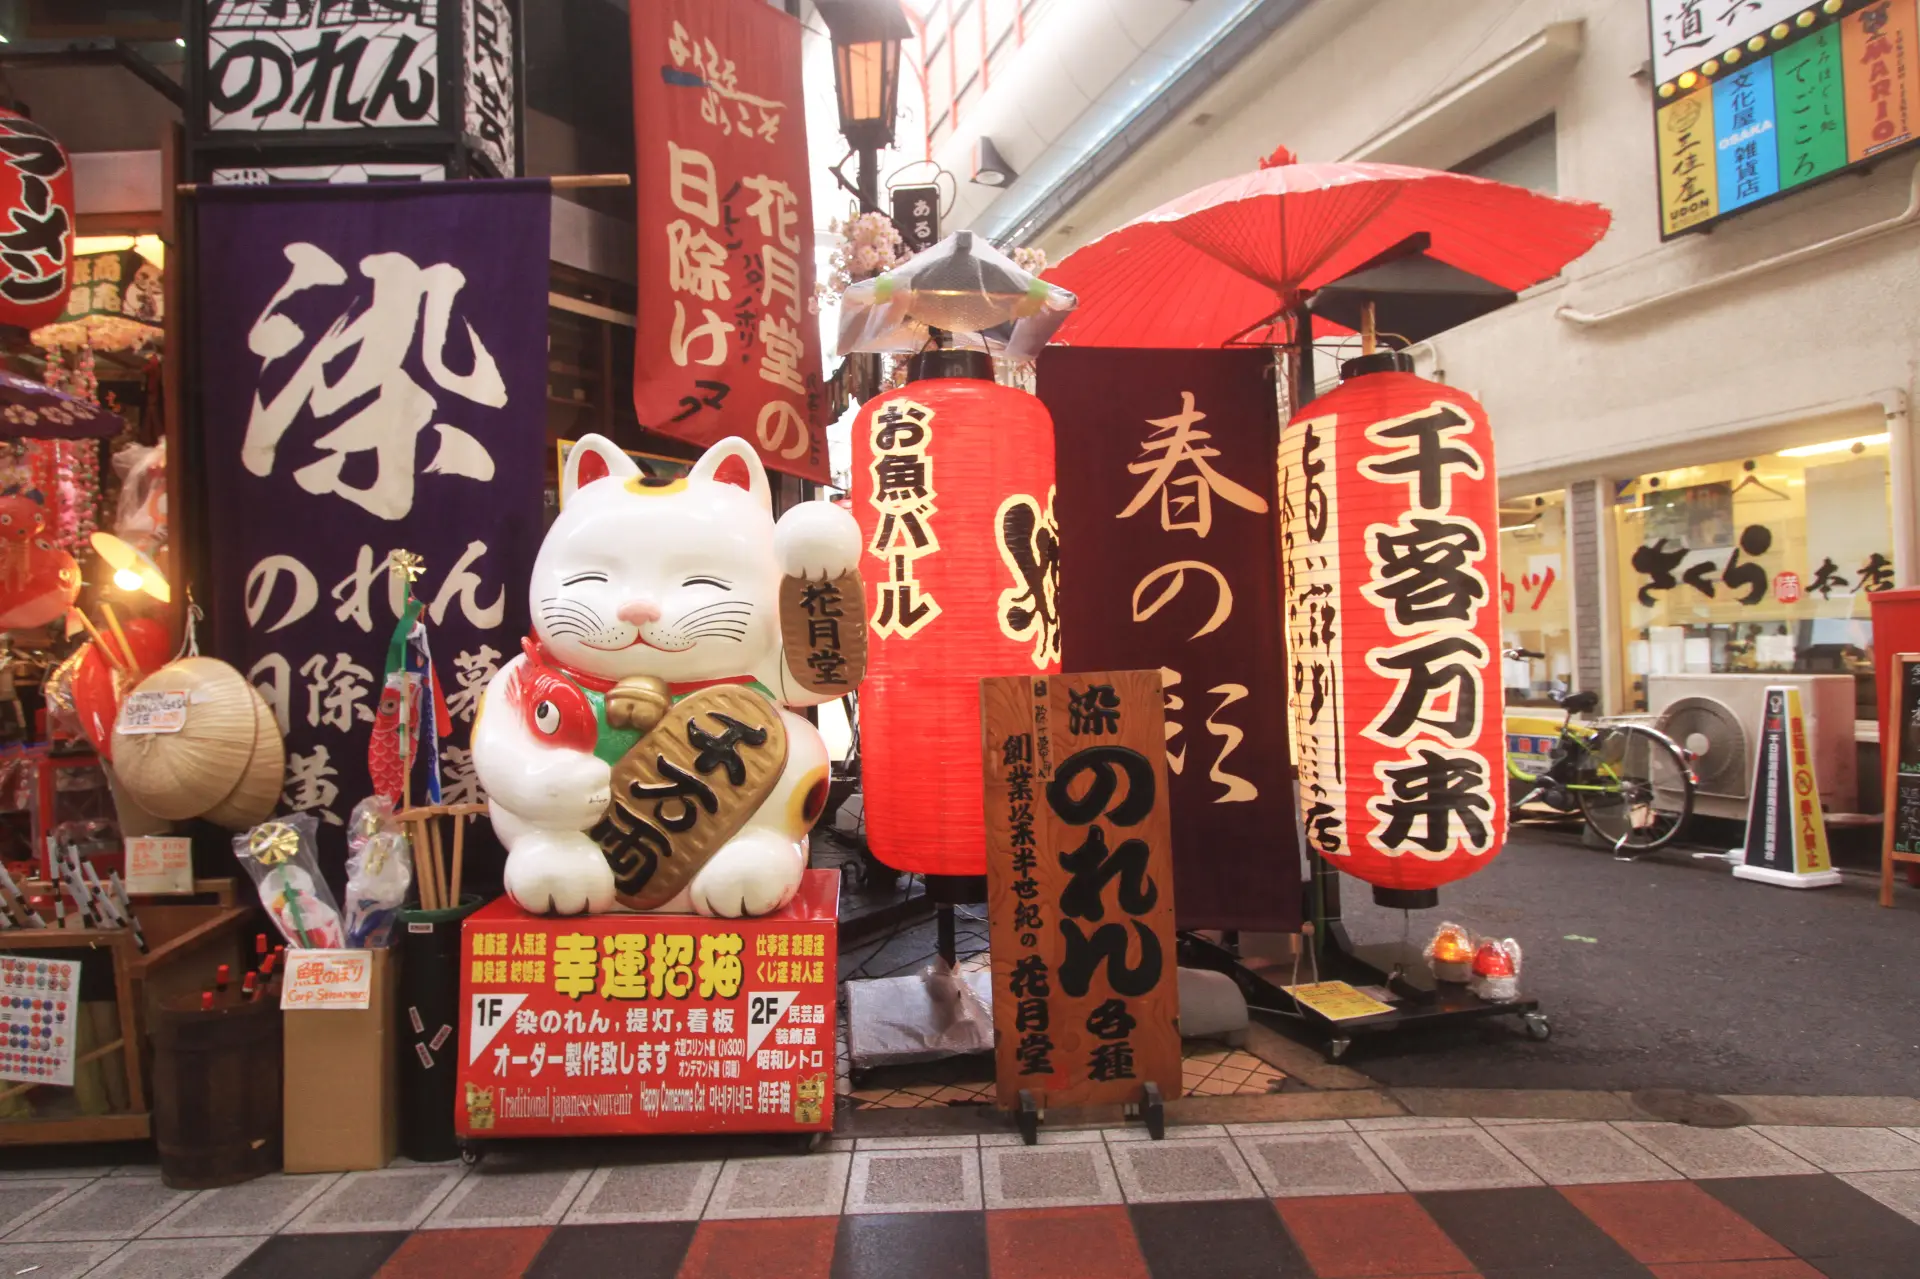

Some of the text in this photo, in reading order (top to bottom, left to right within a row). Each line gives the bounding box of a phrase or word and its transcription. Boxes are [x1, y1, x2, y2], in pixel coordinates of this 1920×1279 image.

[209, 31, 435, 123] のれん
[1731, 72, 1756, 130] 文化屋
[1860, 35, 1895, 141] MARIO
[1719, 120, 1773, 150] OSAKA
[1670, 198, 1709, 220] UDON
[666, 140, 737, 367] 日除け
[742, 174, 810, 461] 花月堂の
[242, 242, 508, 520] 染
[875, 404, 931, 629] お魚バール
[245, 540, 505, 633] のれん
[1631, 524, 1772, 607] さくら
[1804, 552, 1895, 601] 本店
[800, 582, 848, 686] 花月堂
[1368, 406, 1490, 853] 千客万来
[1002, 733, 1055, 1077] 創業以来半世紀の花月堂
[1046, 683, 1163, 1081] 染のれん各種
[553, 932, 743, 1000] 幸運招猫
[756, 934, 789, 957] 仕事運
[756, 961, 789, 984] くじ運
[477, 998, 503, 1027] 1F
[751, 997, 779, 1025] 2F
[775, 1028, 817, 1045] 装飾品
[787, 1005, 825, 1024] 民芸品
[493, 1041, 671, 1078] オーダー製作致します
[756, 1049, 823, 1071] 昭和レトロ
[499, 1084, 633, 1124] Traditional japanese souvenir
[640, 1081, 660, 1119] Happy
